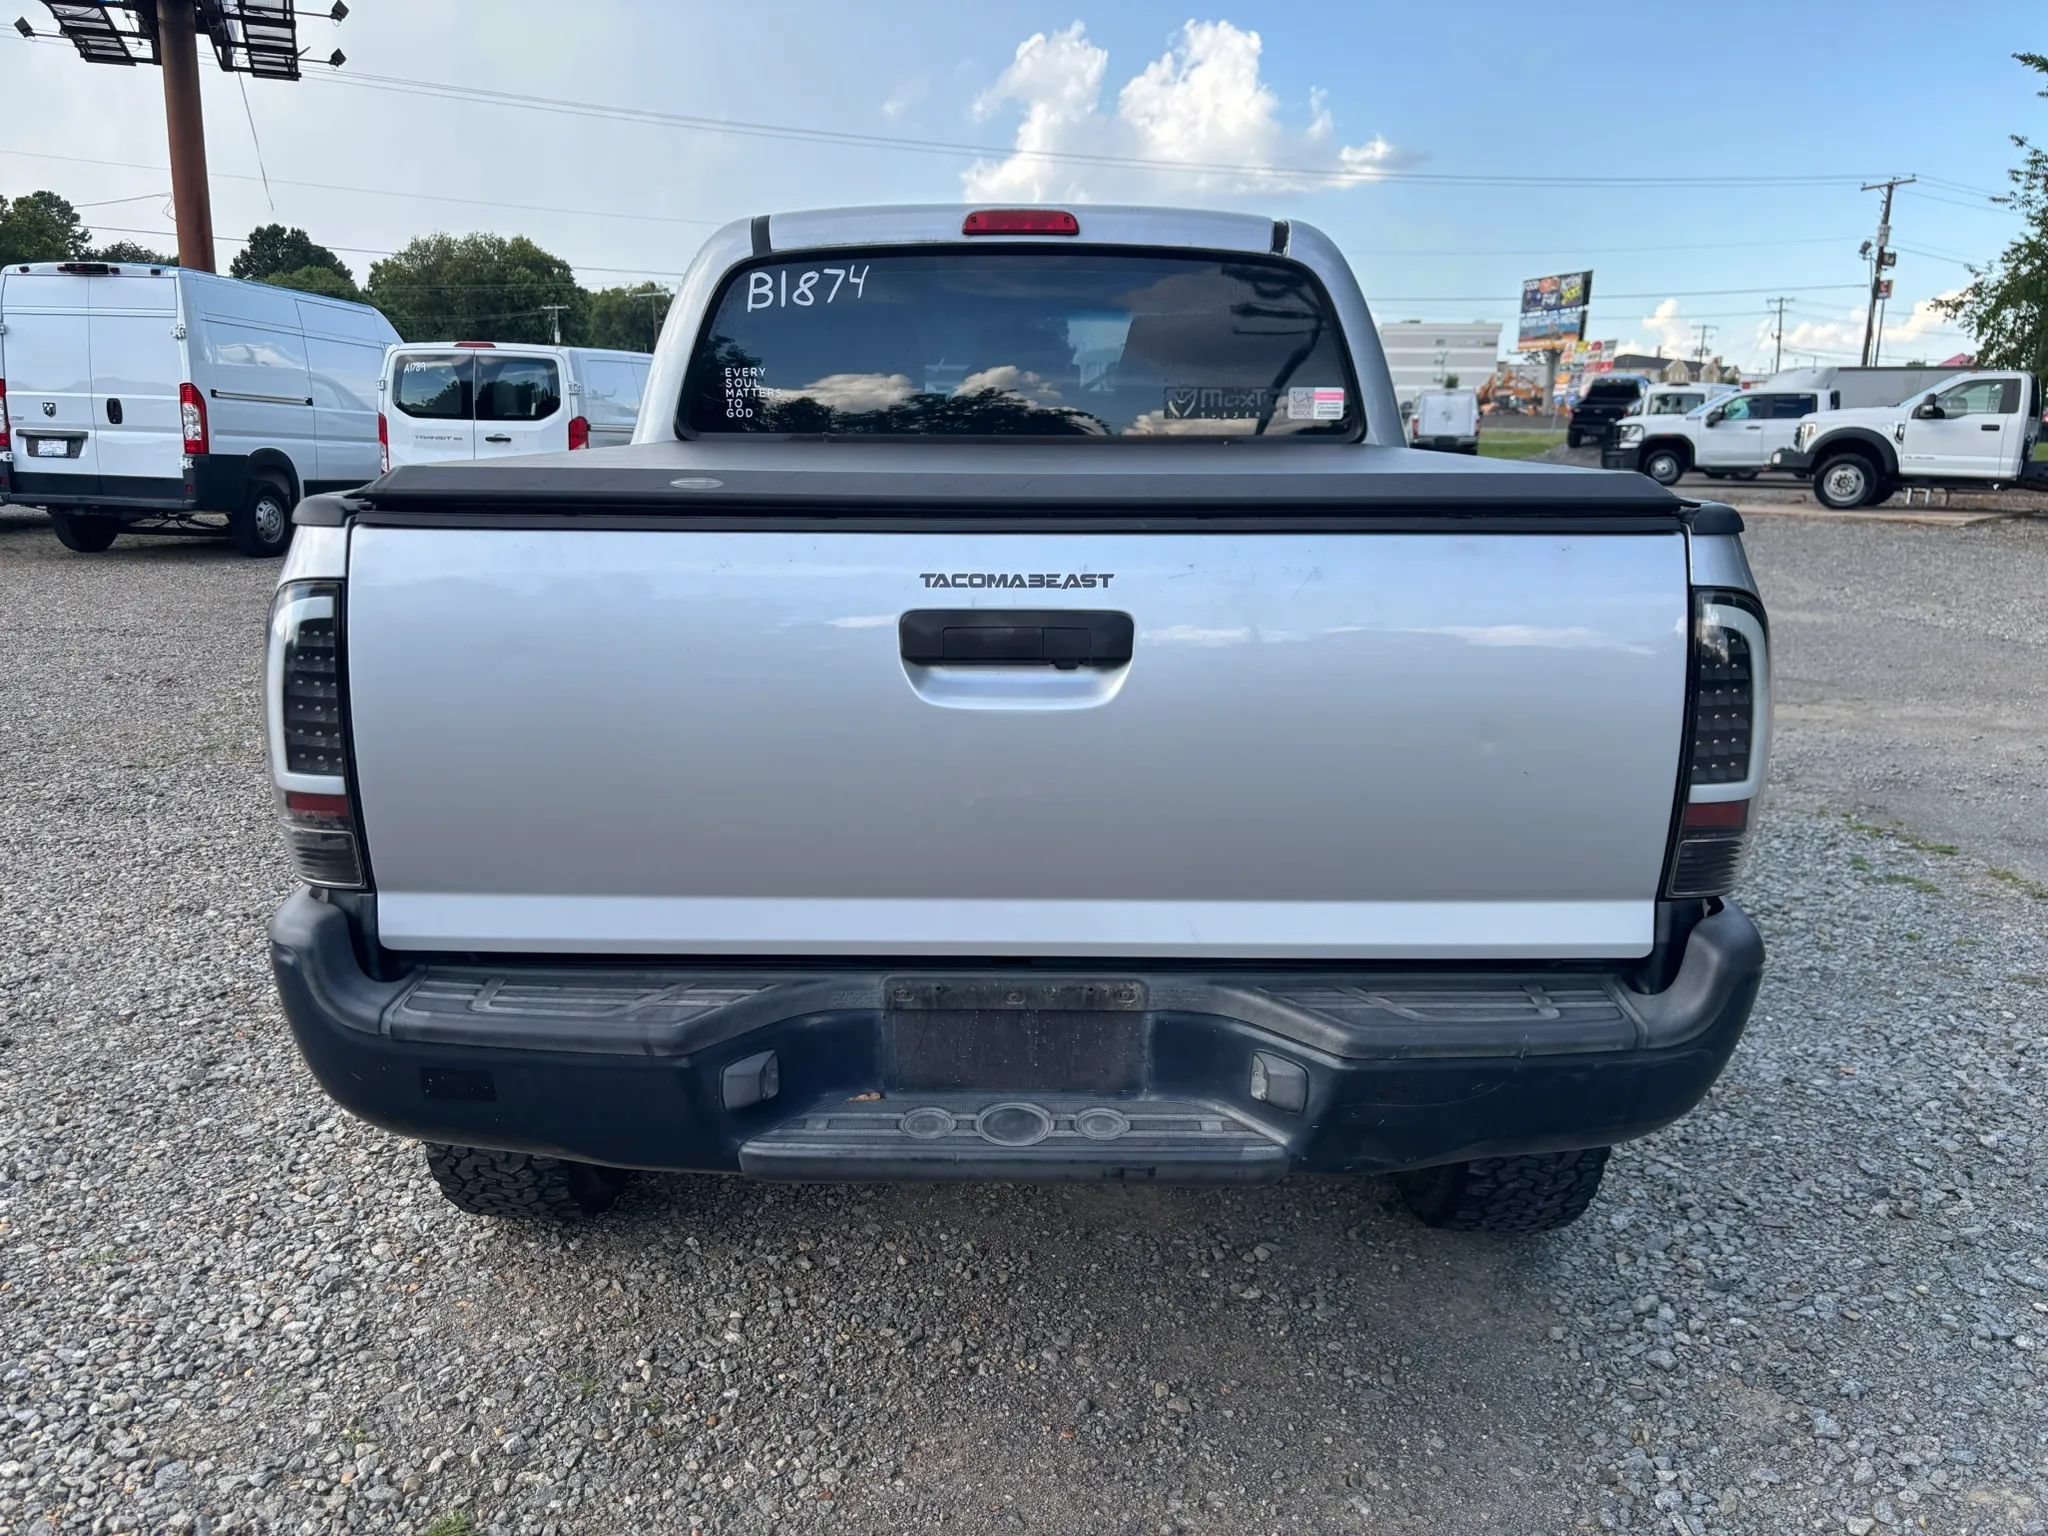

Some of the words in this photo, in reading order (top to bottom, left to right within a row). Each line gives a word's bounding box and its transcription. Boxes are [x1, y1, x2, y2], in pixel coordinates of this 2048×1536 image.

[747, 264, 870, 313] B1874
[724, 367, 766, 377] EVERY
[725, 378, 760, 388] SOUL
[725, 388, 783, 398] MATTERS
[726, 398, 743, 408] TO
[726, 408, 753, 418] GOD
[919, 573, 1115, 590] TACOMABEAST
